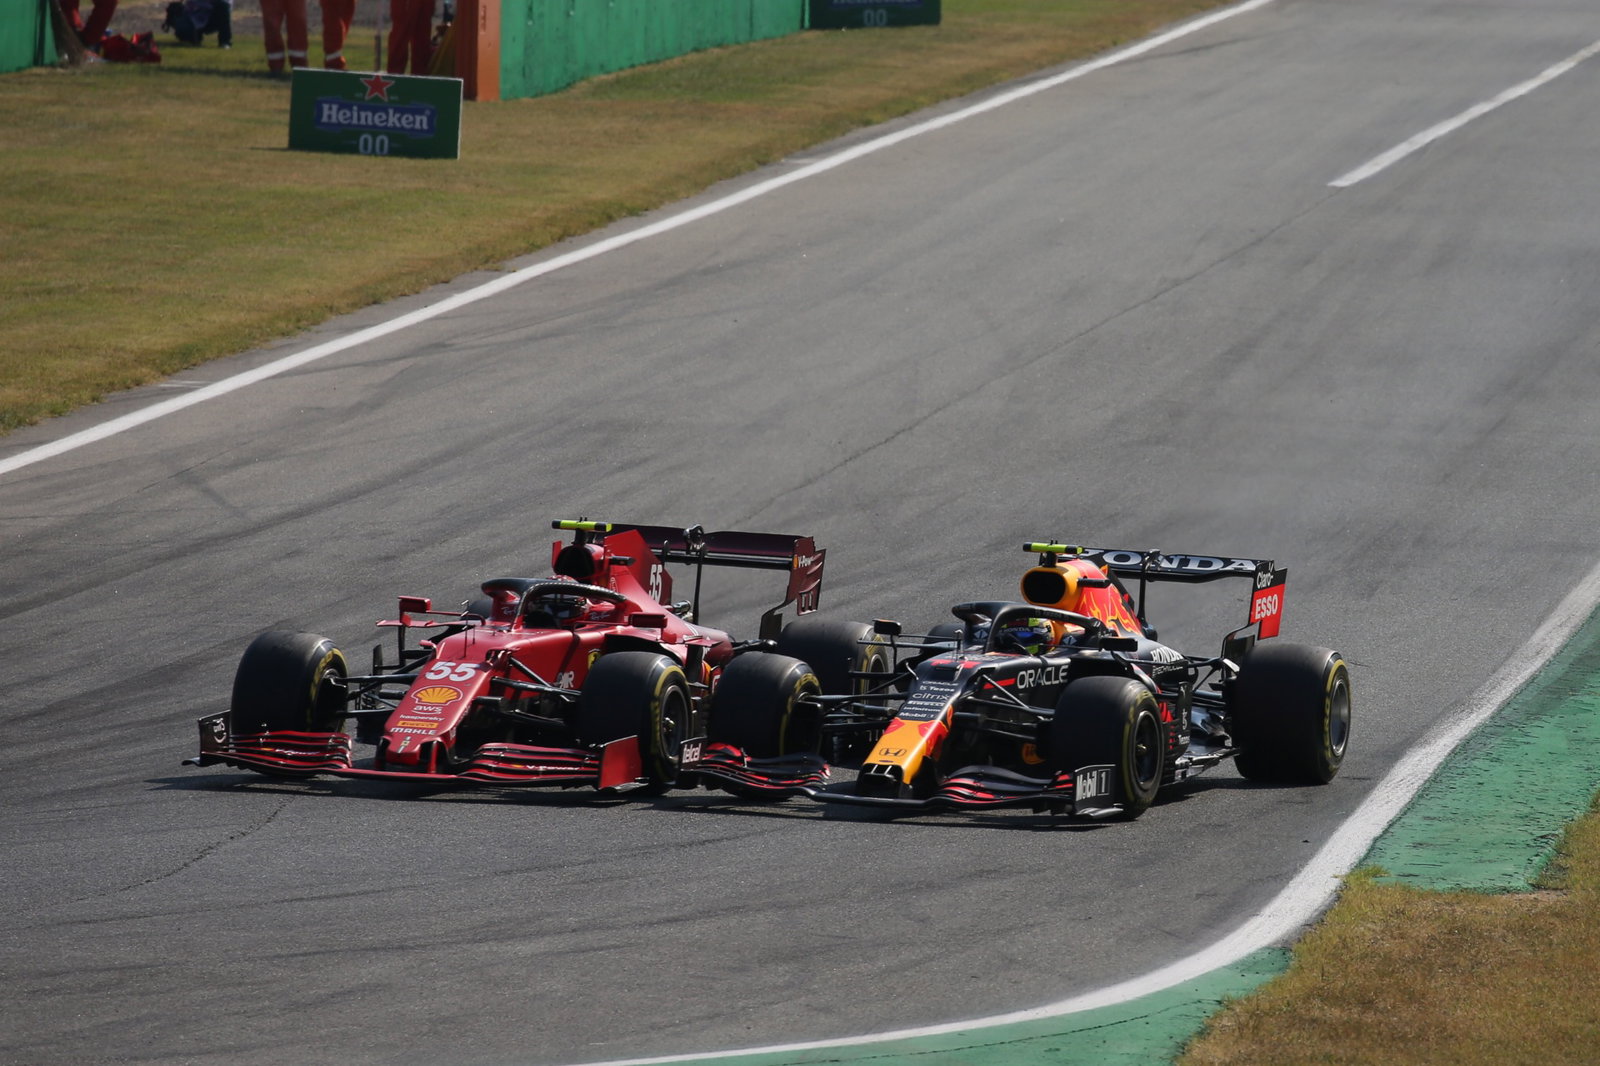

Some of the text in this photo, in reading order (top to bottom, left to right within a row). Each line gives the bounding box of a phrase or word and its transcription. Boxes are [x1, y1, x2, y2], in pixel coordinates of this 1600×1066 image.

[320, 103, 429, 130] Heineken
[649, 563, 663, 604] 55
[1254, 593, 1279, 619] ESSO
[425, 661, 481, 682] 55
[1016, 665, 1069, 689] ORACLE
[912, 692, 950, 700] citrix
[413, 705, 443, 713] aws
[389, 727, 437, 735] MAHLE
[682, 743, 702, 763] telcel
[1075, 770, 1098, 801] Mobil
